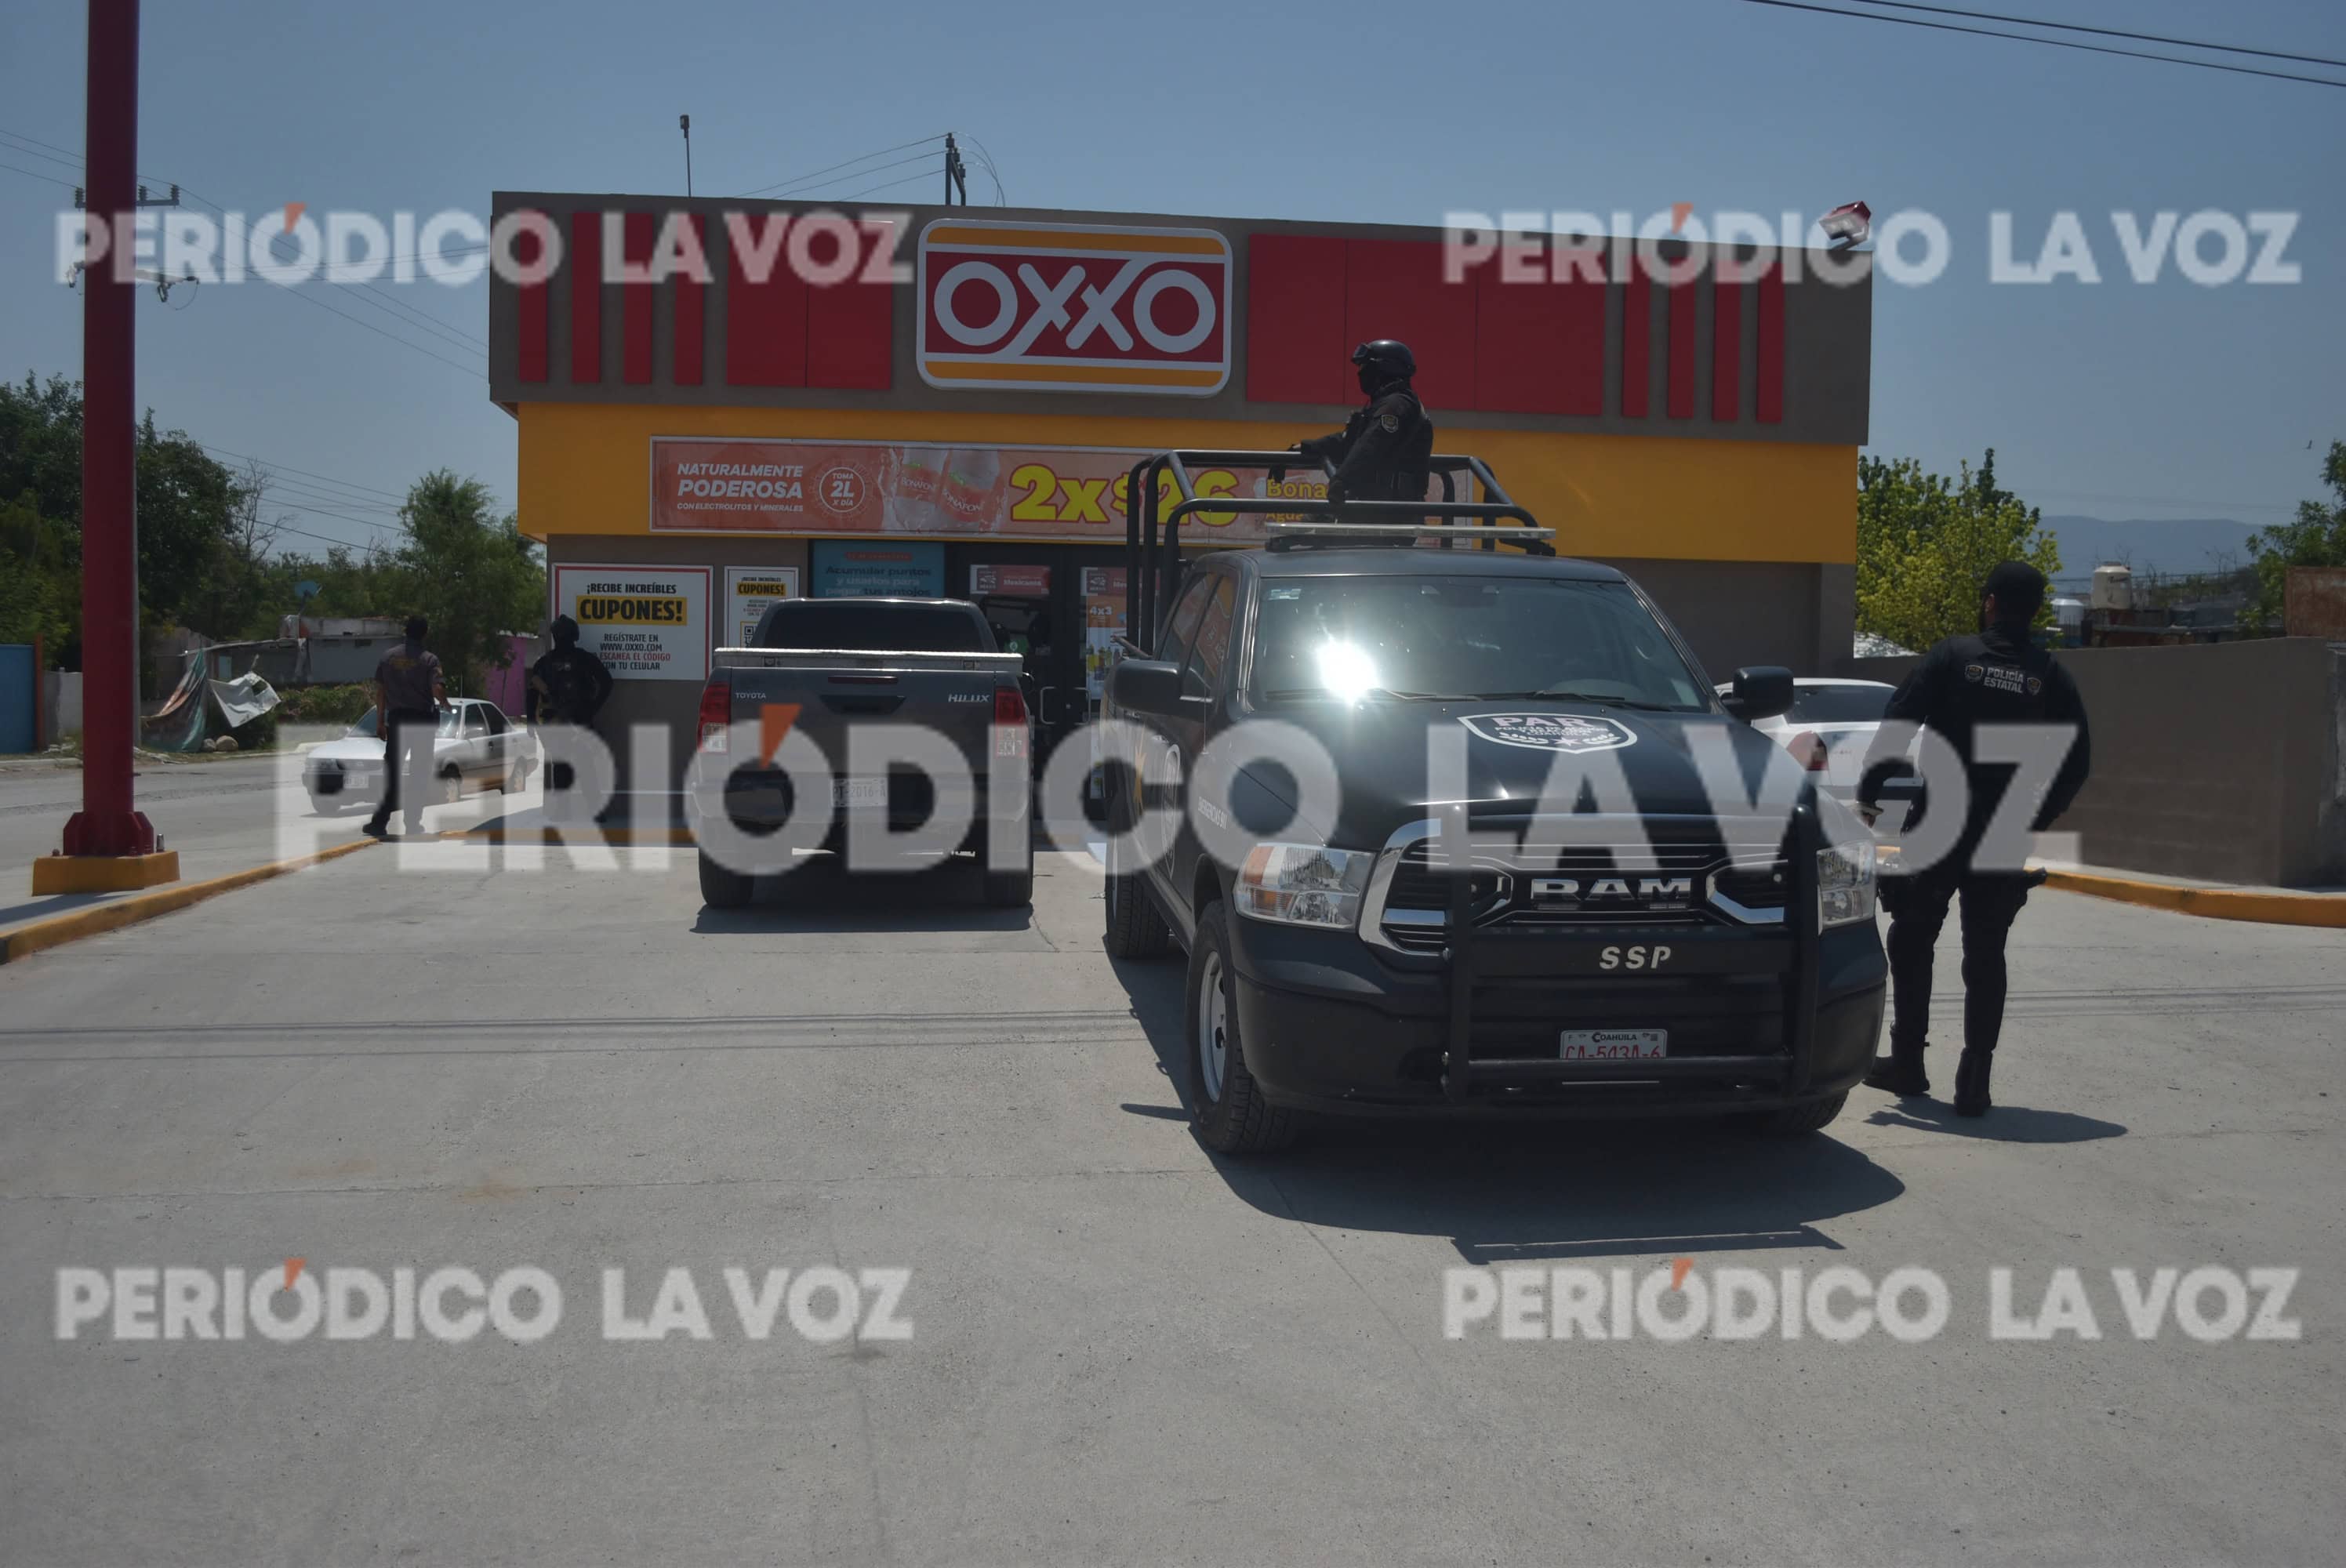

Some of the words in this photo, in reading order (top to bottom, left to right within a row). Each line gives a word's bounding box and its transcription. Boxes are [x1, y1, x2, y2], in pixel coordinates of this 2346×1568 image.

[933, 260, 1216, 354] OXXO
[677, 463, 804, 477] NATURALMENTE
[677, 480, 804, 499] PODEROSA
[831, 481, 854, 498] 2L
[1266, 477, 1328, 499] Bona
[695, 503, 750, 511] ELECTROLITOS
[759, 504, 804, 513] MINERALES
[826, 565, 886, 575] Acumular
[888, 567, 931, 579] puntos
[586, 583, 622, 594] ¡RECIBE
[625, 581, 677, 594] INCREÍBLES
[836, 577, 843, 586] y
[846, 576, 891, 586] usarlos
[892, 578, 921, 587] para
[738, 583, 784, 596] CUPONES!
[863, 587, 884, 597] tus
[885, 586, 932, 597] antojos
[579, 599, 683, 622] CUPONES!
[1089, 604, 1113, 616] 4x3
[604, 632, 647, 643] REGÍSTRATE
[649, 633, 659, 643] EN
[599, 642, 663, 652] WWW.OXXO.COM
[599, 652, 632, 662] ESCANEA
[633, 652, 642, 662] EL
[643, 651, 671, 662] CÓDIGO
[618, 662, 628, 671] TU
[630, 662, 660, 671] CELULAR
[1986, 666, 2025, 683] POLICÍA
[1984, 677, 2024, 694] ESTATAL
[947, 693, 991, 703] HILUX
[1491, 717, 1594, 728] PAR
[1531, 878, 1692, 901] RAM
[1599, 945, 1672, 970] SSP
[1592, 1032, 1637, 1043] COAHUILA
